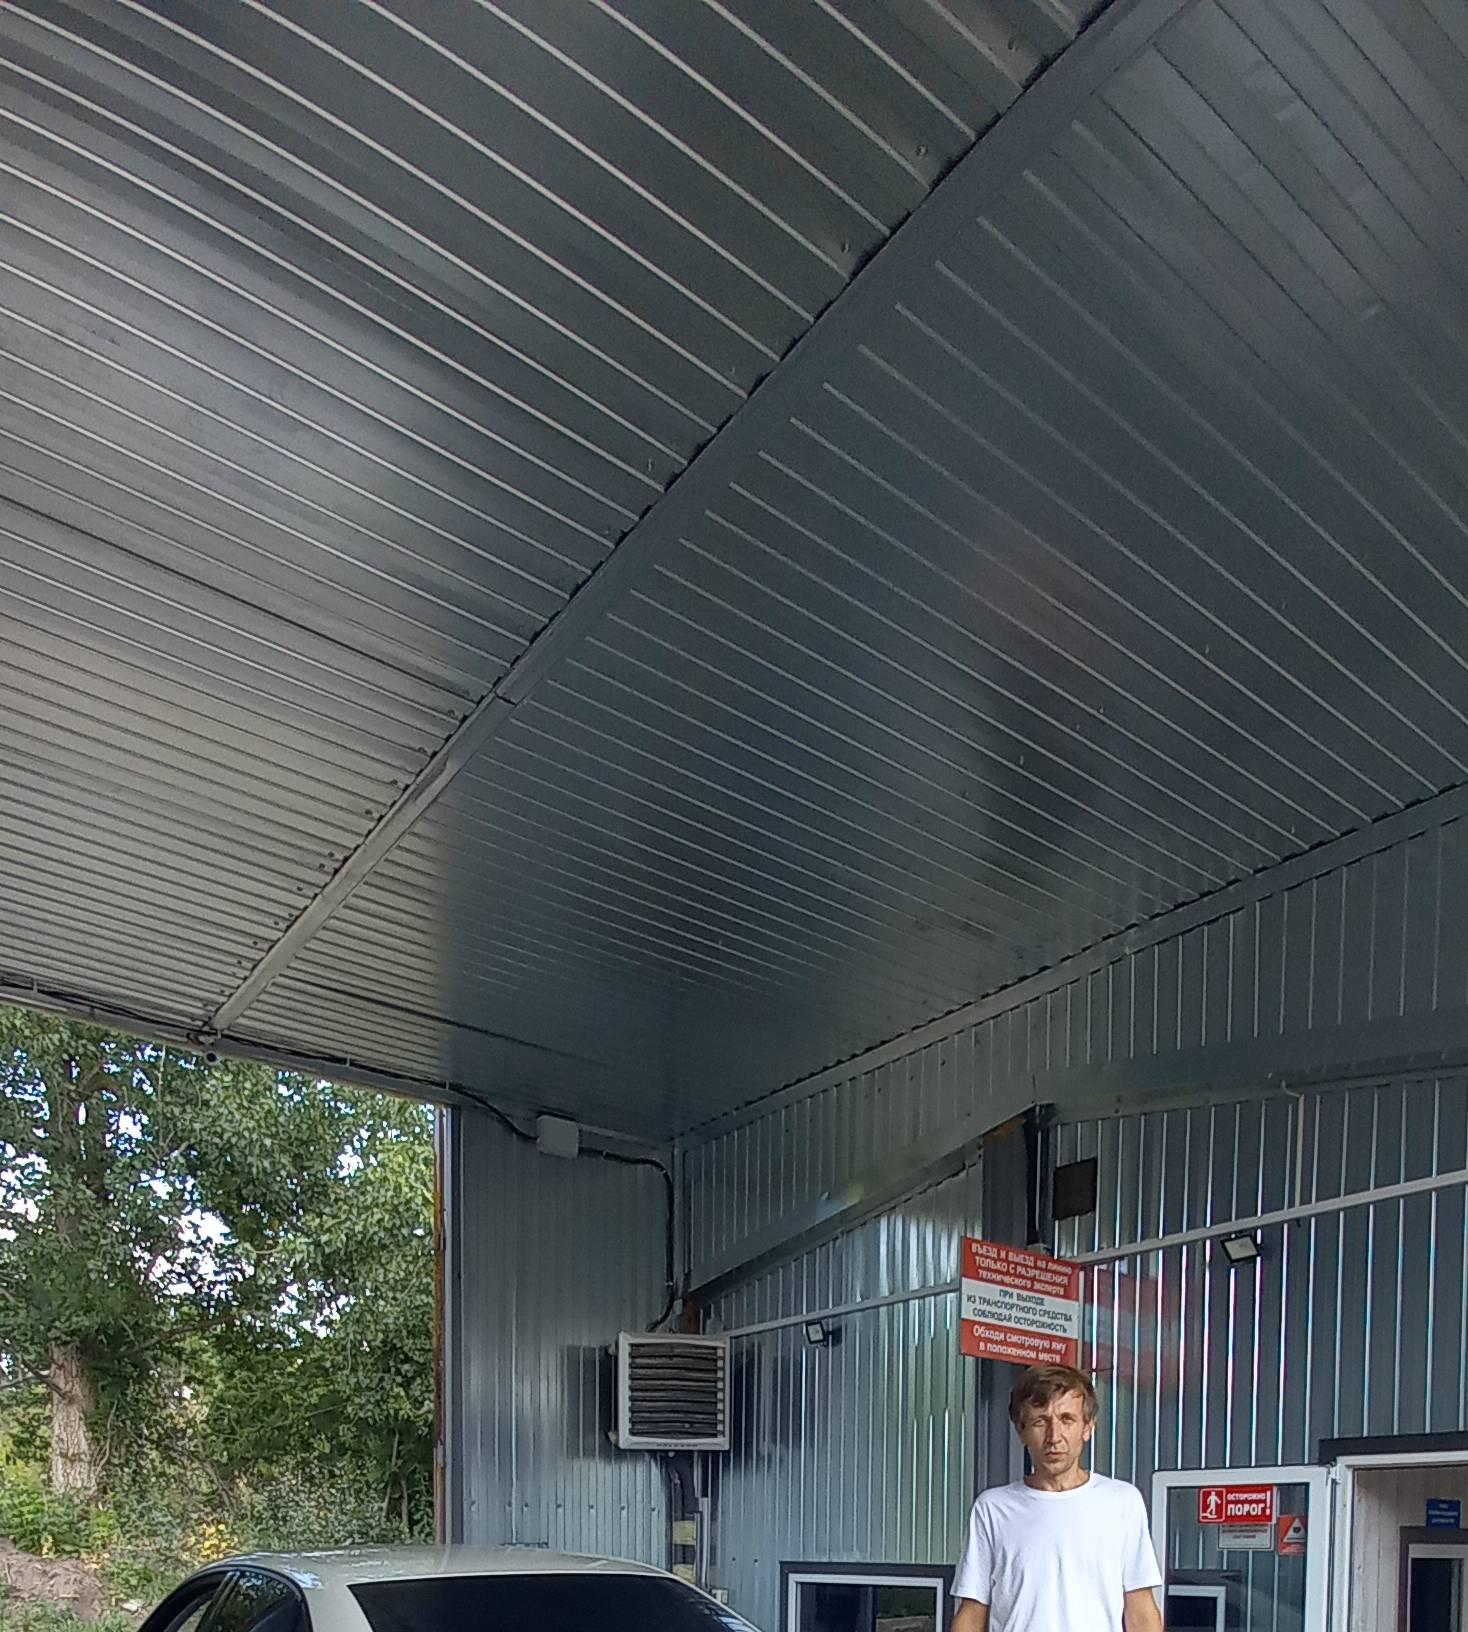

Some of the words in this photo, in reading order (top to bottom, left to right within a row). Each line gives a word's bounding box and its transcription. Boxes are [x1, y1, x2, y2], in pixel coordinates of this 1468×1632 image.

[971, 1243, 998, 1259] ВЪЕЗД
[999, 1250, 1007, 1260] И
[1008, 1252, 1035, 1267] ВЫЕЗД
[975, 1256, 1008, 1273] ТОЛЬКО
[1009, 1264, 1015, 1274] С
[1016, 1266, 1069, 1286] РАЗРЕШЕНИЯ
[967, 1294, 977, 1304] ИЗ
[978, 1296, 1038, 1317] ТРАНСПОРТНОГО
[1038, 1308, 1073, 1322] СРЕДСТВА
[999, 1289, 1014, 1299] ПРИ
[1016, 1293, 1046, 1306] ВЫХОДЕ
[972, 1308, 1013, 1323] СОБЛЮДАЙ
[1013, 1316, 1068, 1333] ОСТОРОЖНОСТЬ
[973, 1325, 1005, 1342] Обходи
[1006, 1333, 1051, 1350] смотровую
[1226, 1492, 1266, 1501] ОСТОРОЖНО
